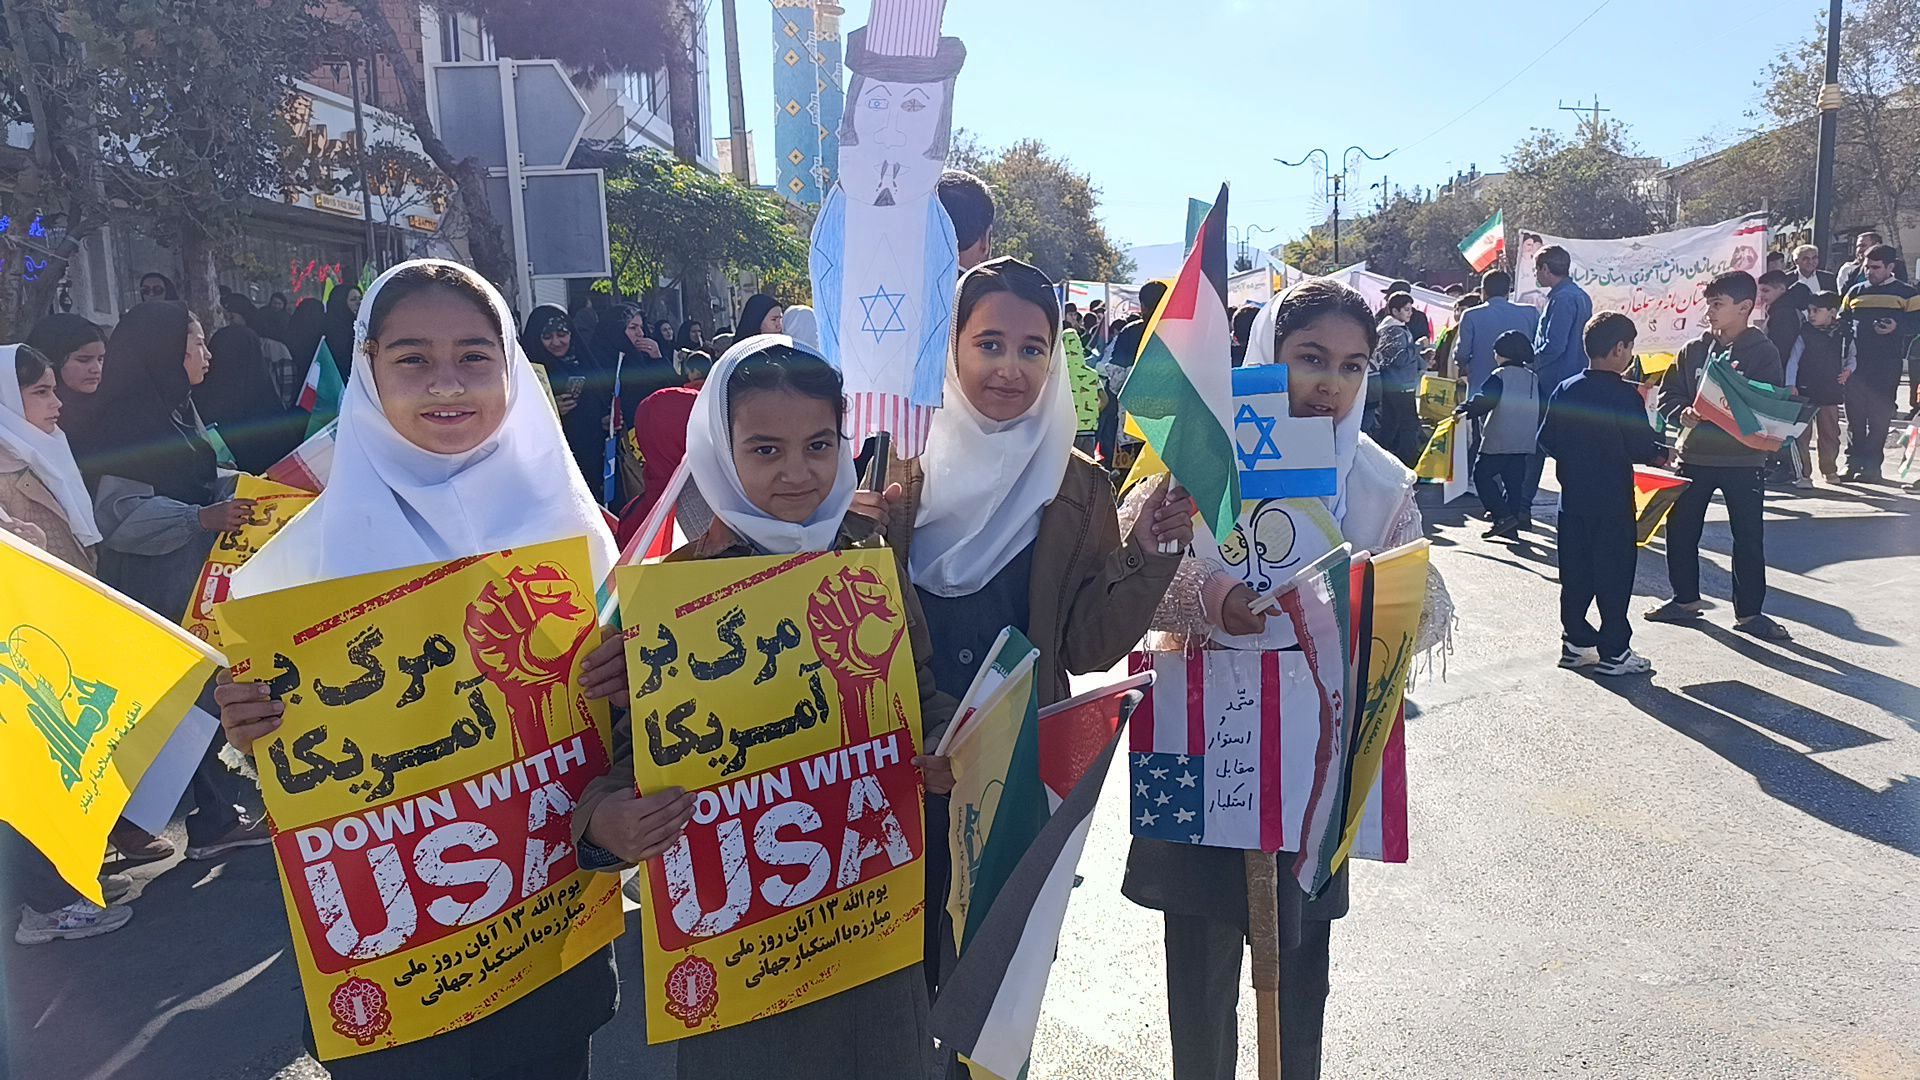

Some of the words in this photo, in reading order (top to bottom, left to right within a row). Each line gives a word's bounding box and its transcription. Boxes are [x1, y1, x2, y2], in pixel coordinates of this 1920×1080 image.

[1571, 267, 1598, 286] خراسا
[1600, 268, 1626, 286] استان
[1629, 263, 1662, 286] آموزی
[1660, 258, 1685, 283] دانش
[635, 622, 679, 699] بر
[688, 604, 802, 685] مرگ
[254, 652, 301, 705] ب
[313, 624, 456, 708] مرگ
[644, 659, 830, 776] آمریکا
[269, 672, 497, 802] آمریکا
[1208, 730, 1251, 750] استوار
[690, 767, 792, 826] OWN
[800, 734, 900, 791] WITH
[1216, 758, 1255, 778] مقابل
[295, 789, 458, 862] DOWN
[464, 736, 587, 809] WITH
[304, 780, 577, 960] USA
[662, 774, 913, 937] USA
[531, 891, 555, 918] الله
[557, 879, 581, 905] یوم
[843, 888, 864, 912] الله
[866, 884, 888, 907] یوم
[530, 927, 543, 943] با
[543, 902, 586, 936] مبارزه
[786, 907, 814, 943] آبان
[842, 924, 853, 943] با
[853, 909, 891, 939] مبارزه
[464, 921, 499, 959] آبان
[725, 938, 755, 967] ملی
[758, 932, 783, 956] روز
[793, 926, 841, 970] استکبار
[394, 958, 427, 987] ملی
[433, 950, 462, 975] روز
[479, 933, 530, 983] استکبار
[745, 955, 790, 989] جهانی
[421, 971, 473, 1006] جهانی
